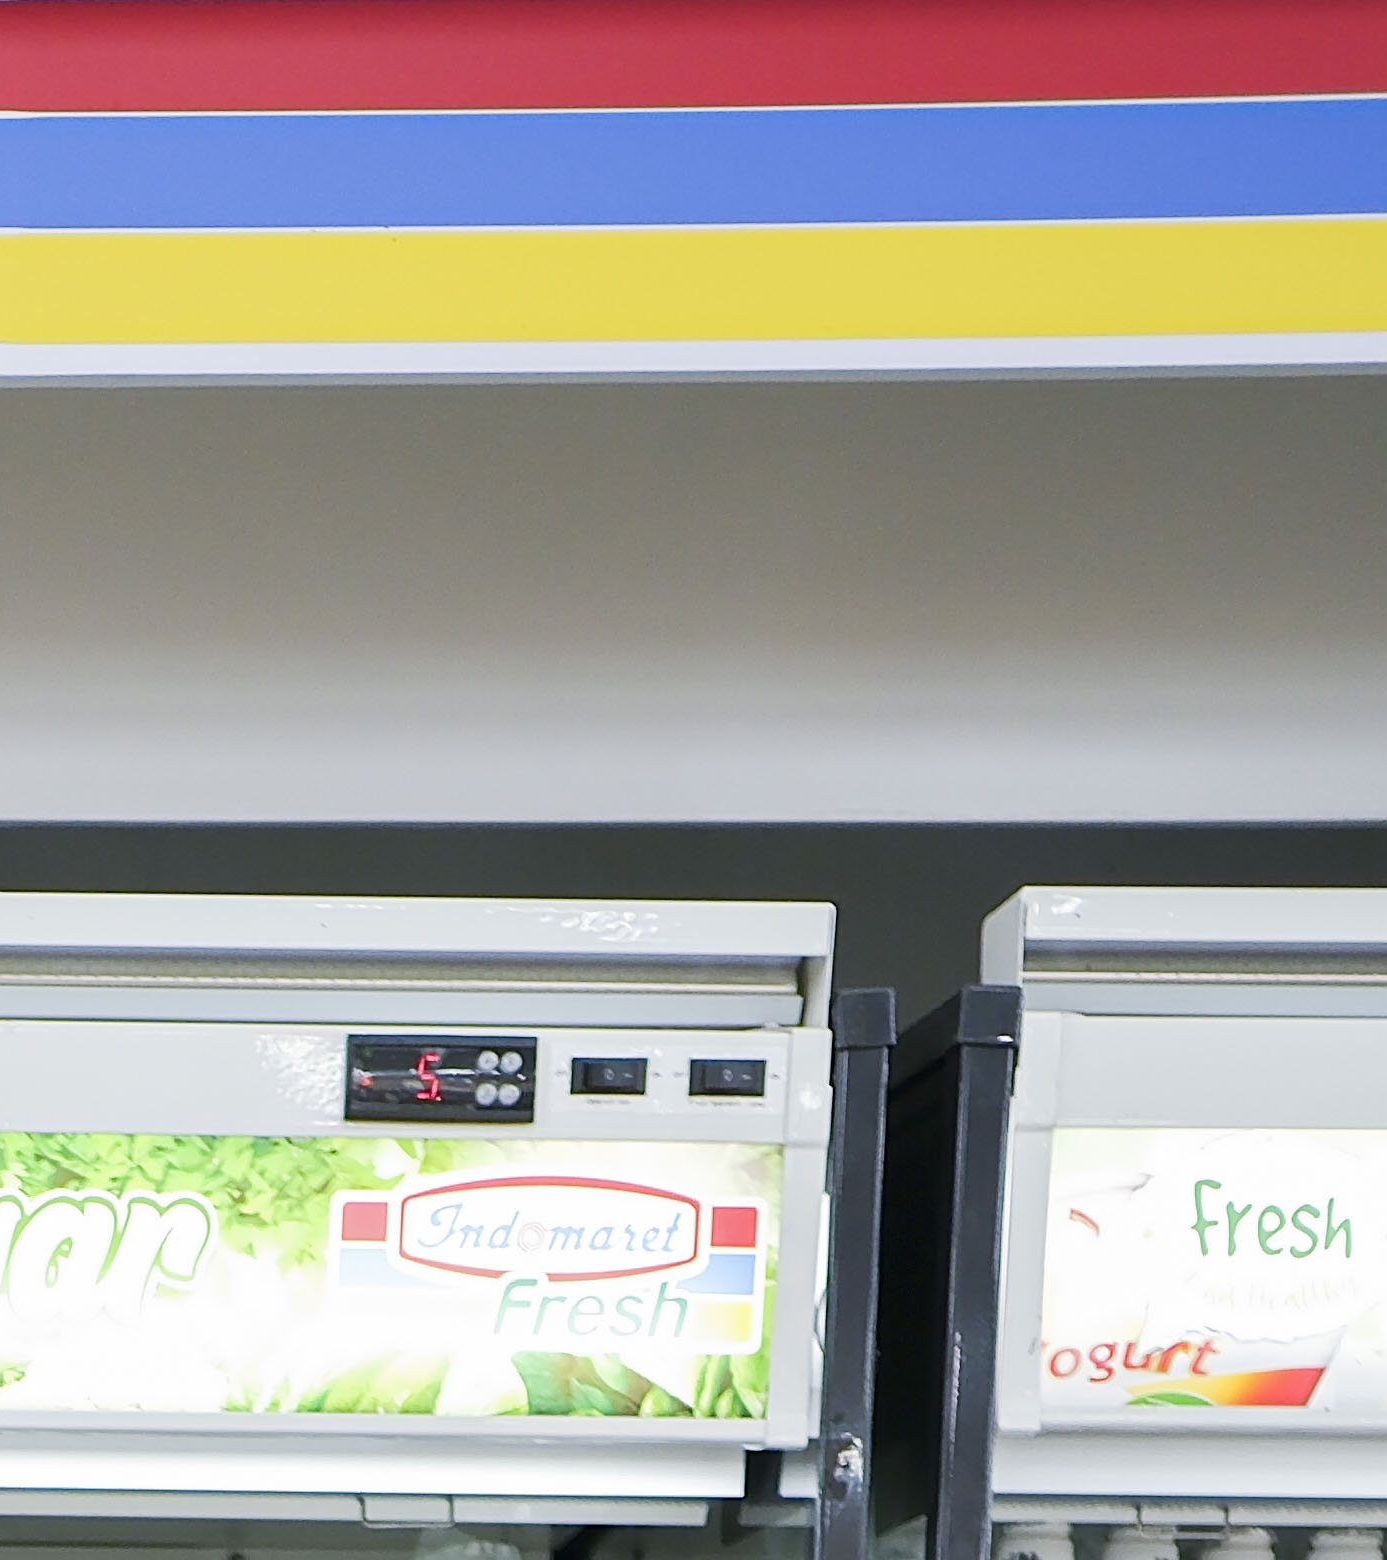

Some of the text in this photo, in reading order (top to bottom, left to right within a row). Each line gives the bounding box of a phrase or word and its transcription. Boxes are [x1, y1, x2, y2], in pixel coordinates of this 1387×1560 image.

[417, 1202, 682, 1254] Indomaret
[492, 1278, 688, 1338] Fresh
[1042, 1338, 1220, 1383] ogurt
